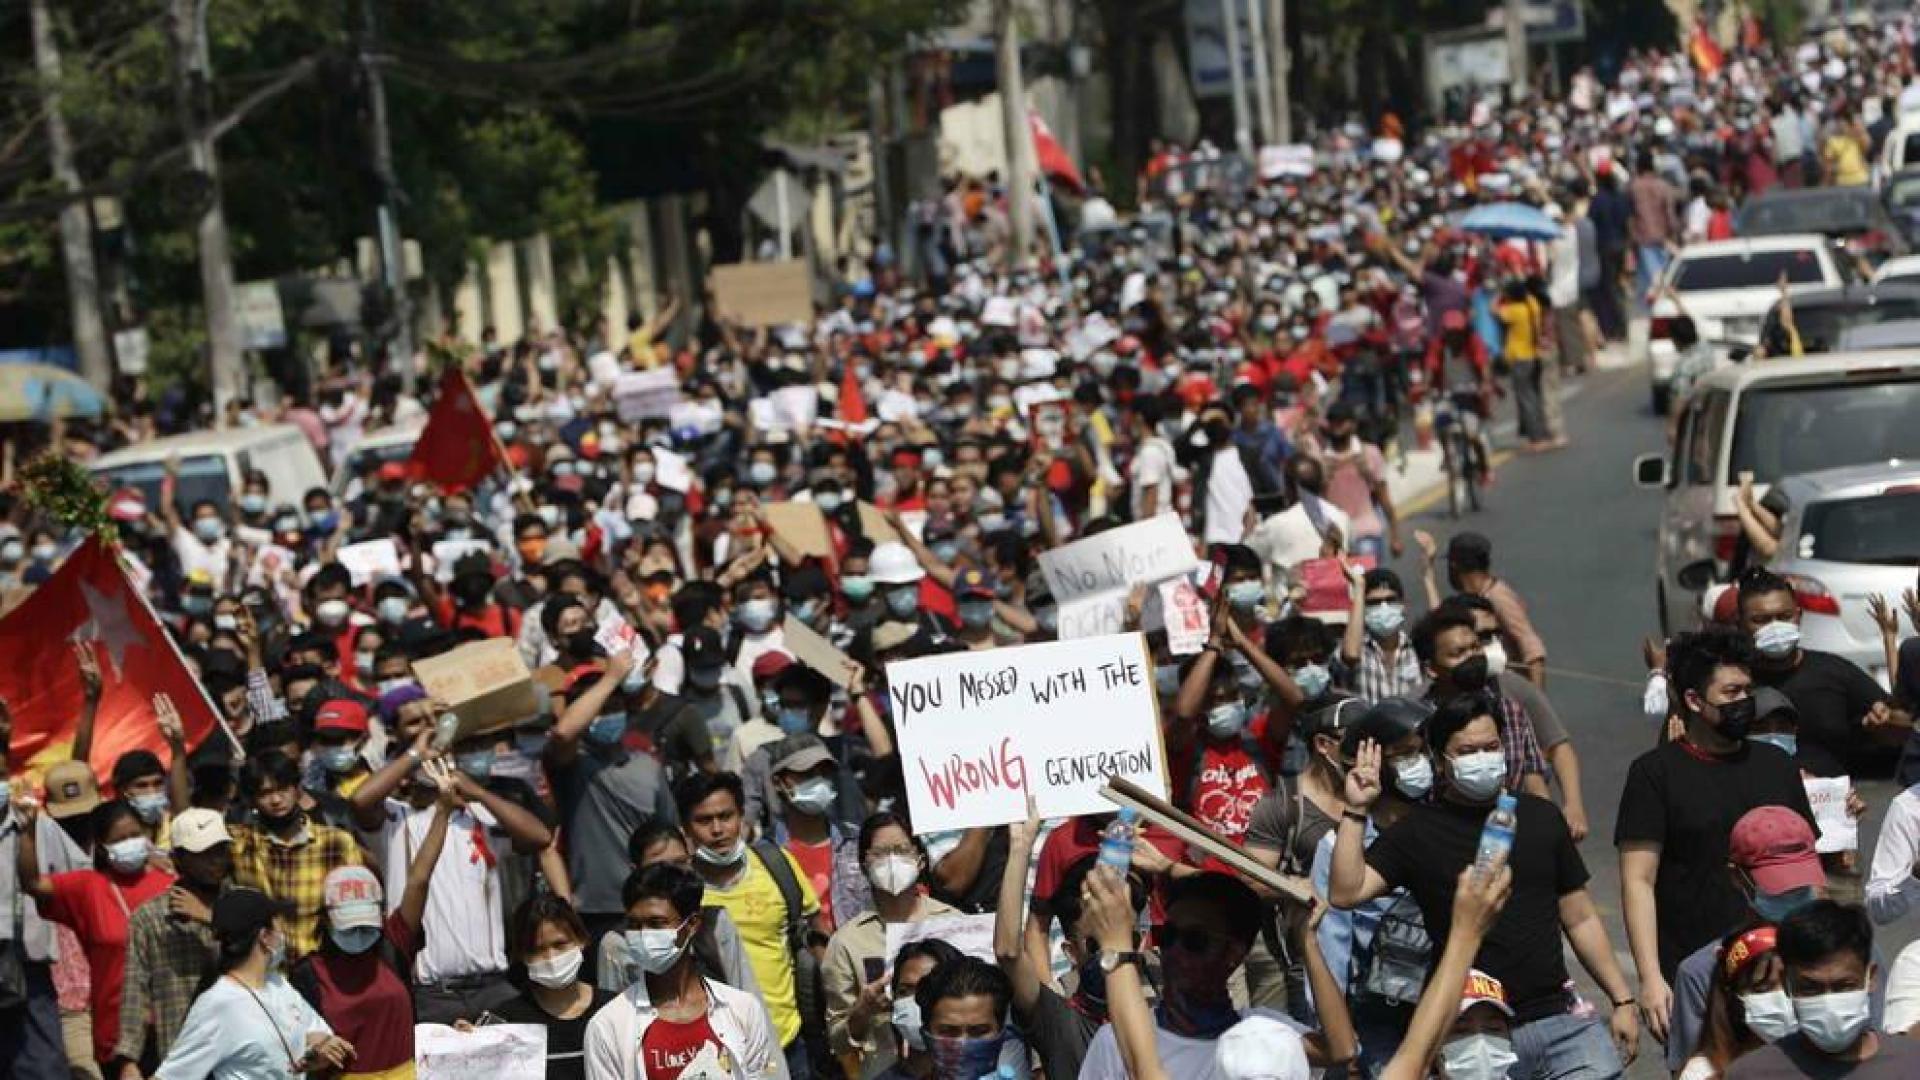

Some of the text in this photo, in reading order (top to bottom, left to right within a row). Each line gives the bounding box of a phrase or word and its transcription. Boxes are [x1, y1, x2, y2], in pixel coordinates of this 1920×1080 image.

[1054, 560, 1097, 597] No
[892, 677, 941, 725] YOU
[1031, 667, 1087, 704] WITH
[1098, 656, 1140, 690] THE
[919, 737, 1153, 810] WRONG GENERATION
